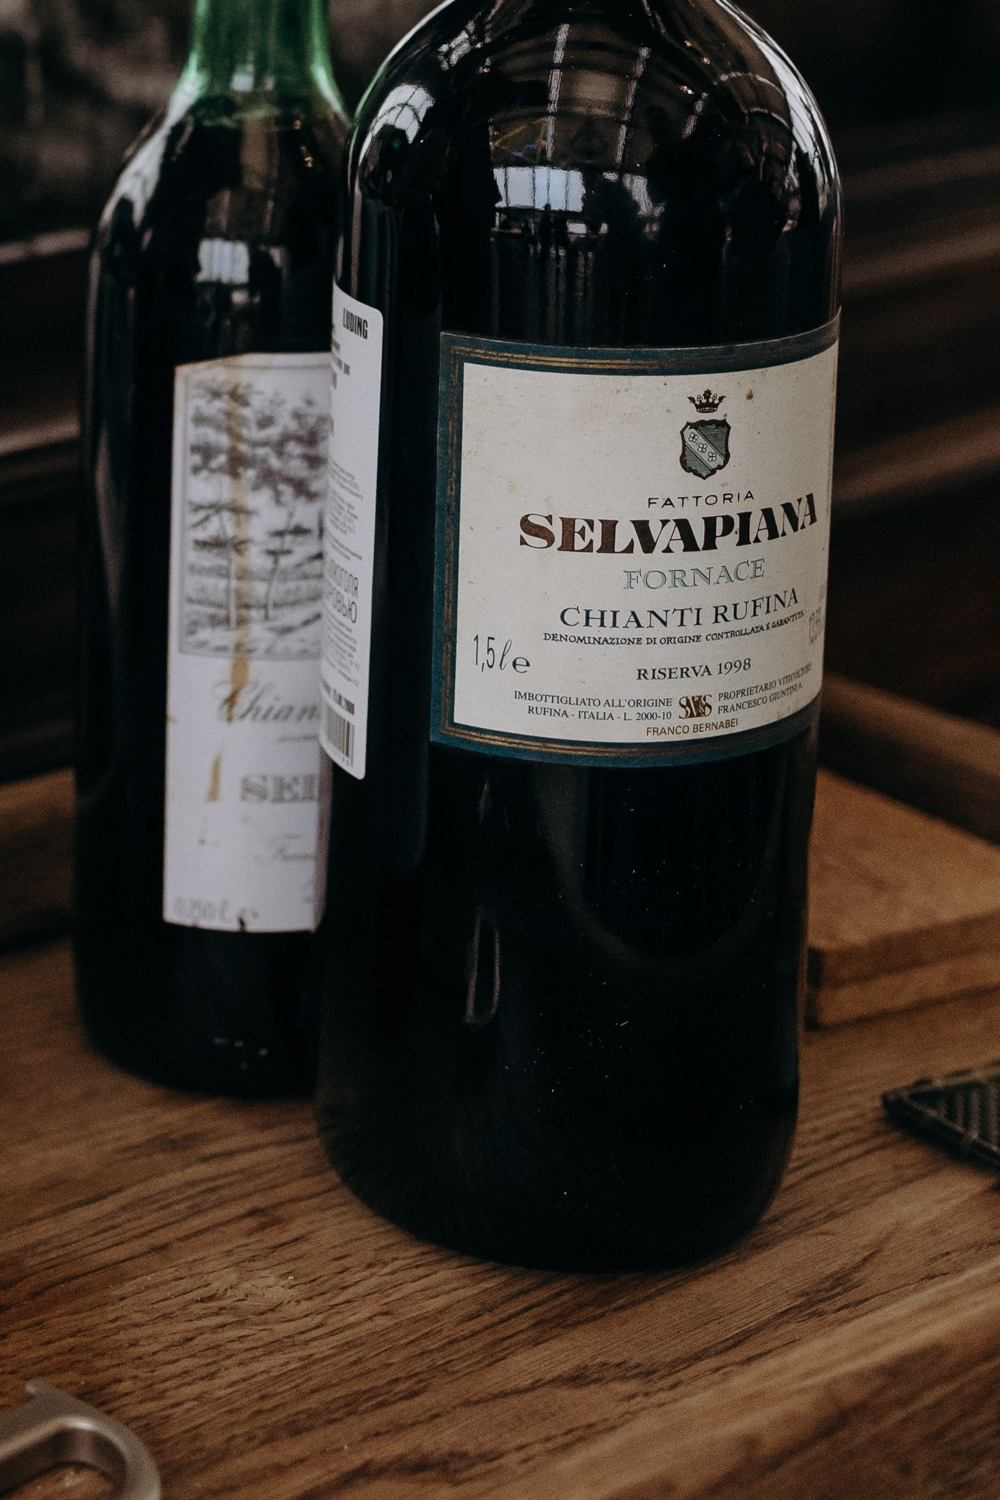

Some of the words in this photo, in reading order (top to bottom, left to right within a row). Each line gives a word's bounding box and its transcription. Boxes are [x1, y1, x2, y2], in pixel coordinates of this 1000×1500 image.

[342, 307, 369, 340] LUDING
[647, 490, 755, 509] FATTORIA
[518, 492, 818, 554] SELVAPIANA
[622, 557, 766, 590] FORNACE
[559, 605, 703, 629] CHIANTI
[711, 587, 799, 625] RUFINA
[543, 632, 643, 646] DENOMINAZIONE
[645, 637, 658, 646] DI
[659, 634, 702, 645] ORIGINE
[705, 626, 765, 642] CONTROLLATA
[765, 622, 771, 632] E
[636, 664, 713, 681] RISERVA
[716, 657, 752, 676] 1998
[513, 690, 601, 707] IMBOTTIGLIATO
[603, 697, 673, 708] ALL'ORIGINE
[717, 679, 777, 702] PROPRIETARIO
[717, 697, 769, 715] FRANCESCO
[768, 683, 798, 703] GIUNTINI
[527, 705, 569, 719] RUFINA
[577, 710, 615, 722] ITALIA
[635, 710, 672, 722] 2000-10
[646, 725, 690, 737] FRANCO
[692, 717, 739, 734] BERNABEI
